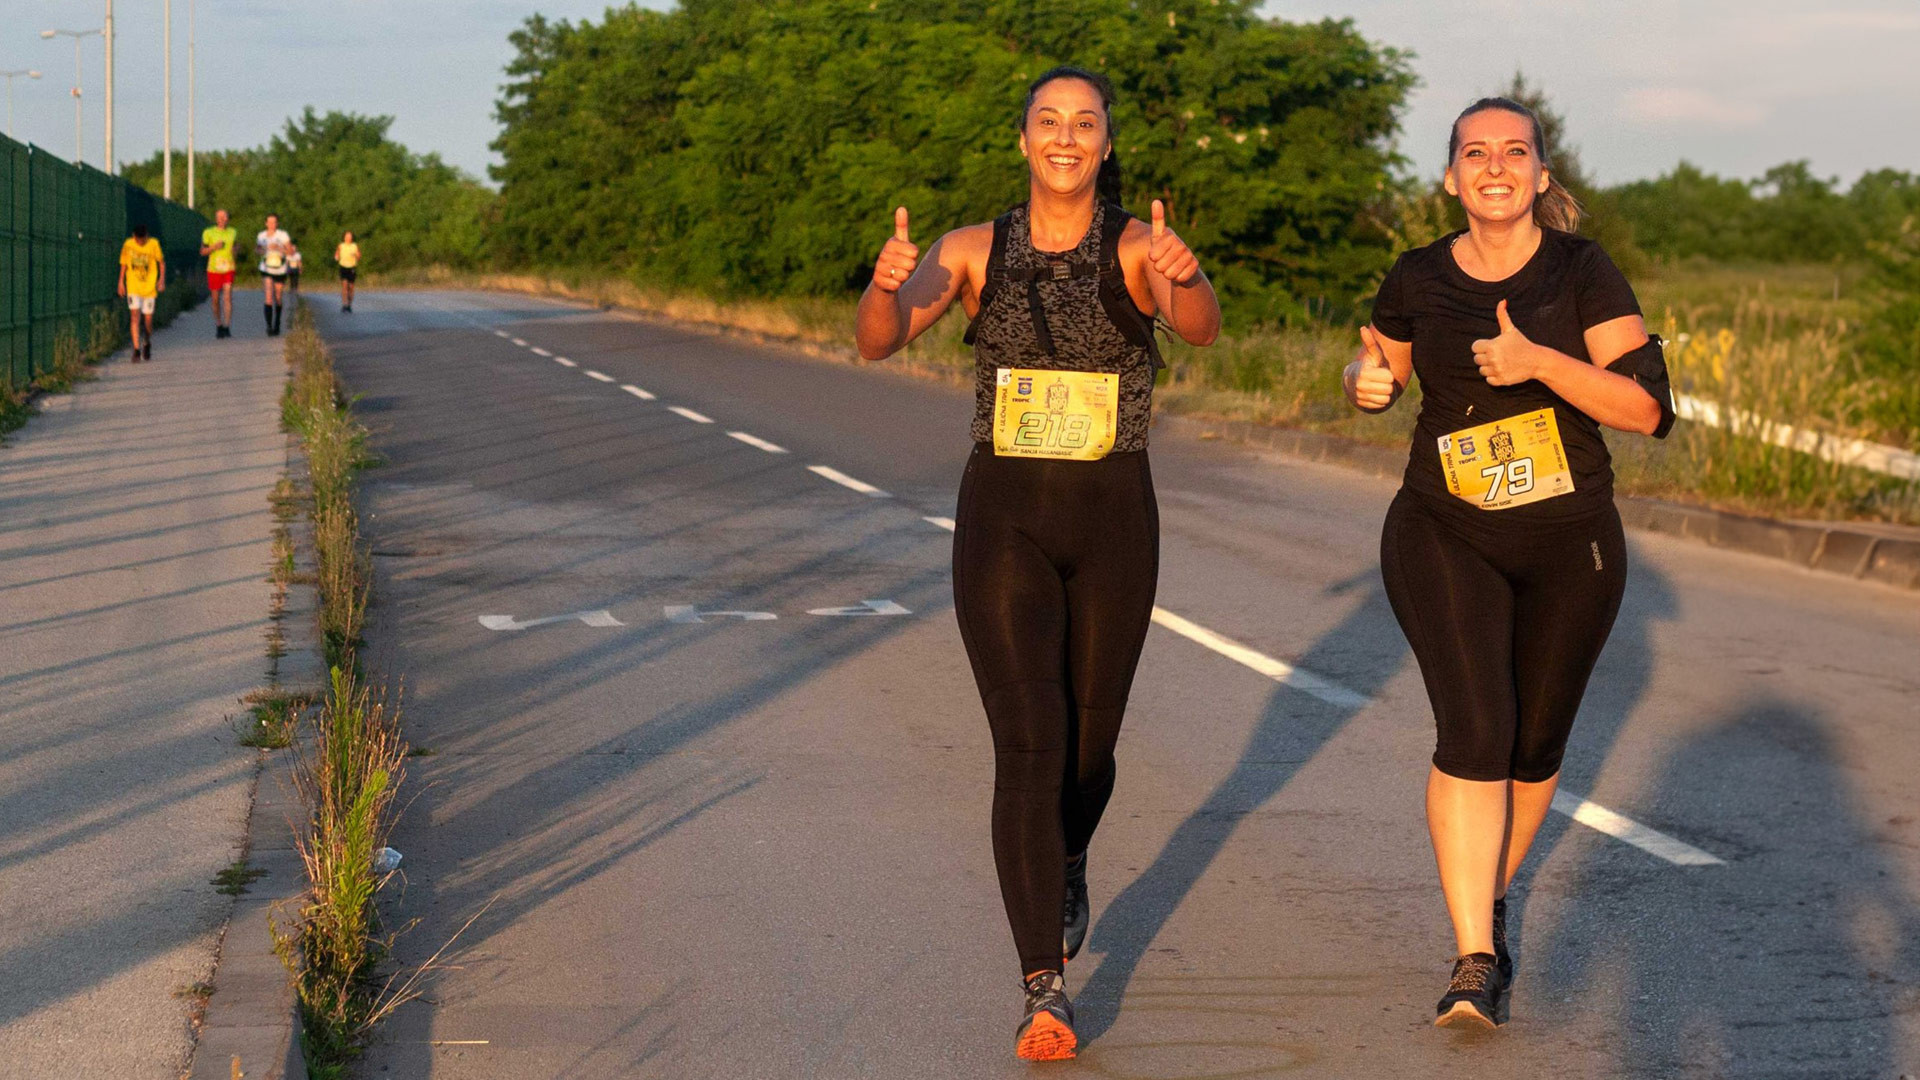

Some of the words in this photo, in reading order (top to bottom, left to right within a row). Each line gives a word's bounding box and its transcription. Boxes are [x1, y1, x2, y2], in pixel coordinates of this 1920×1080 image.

[1015, 412, 1092, 449] 218
[1492, 432, 1509, 443] RUN
[1481, 457, 1534, 502] 79
